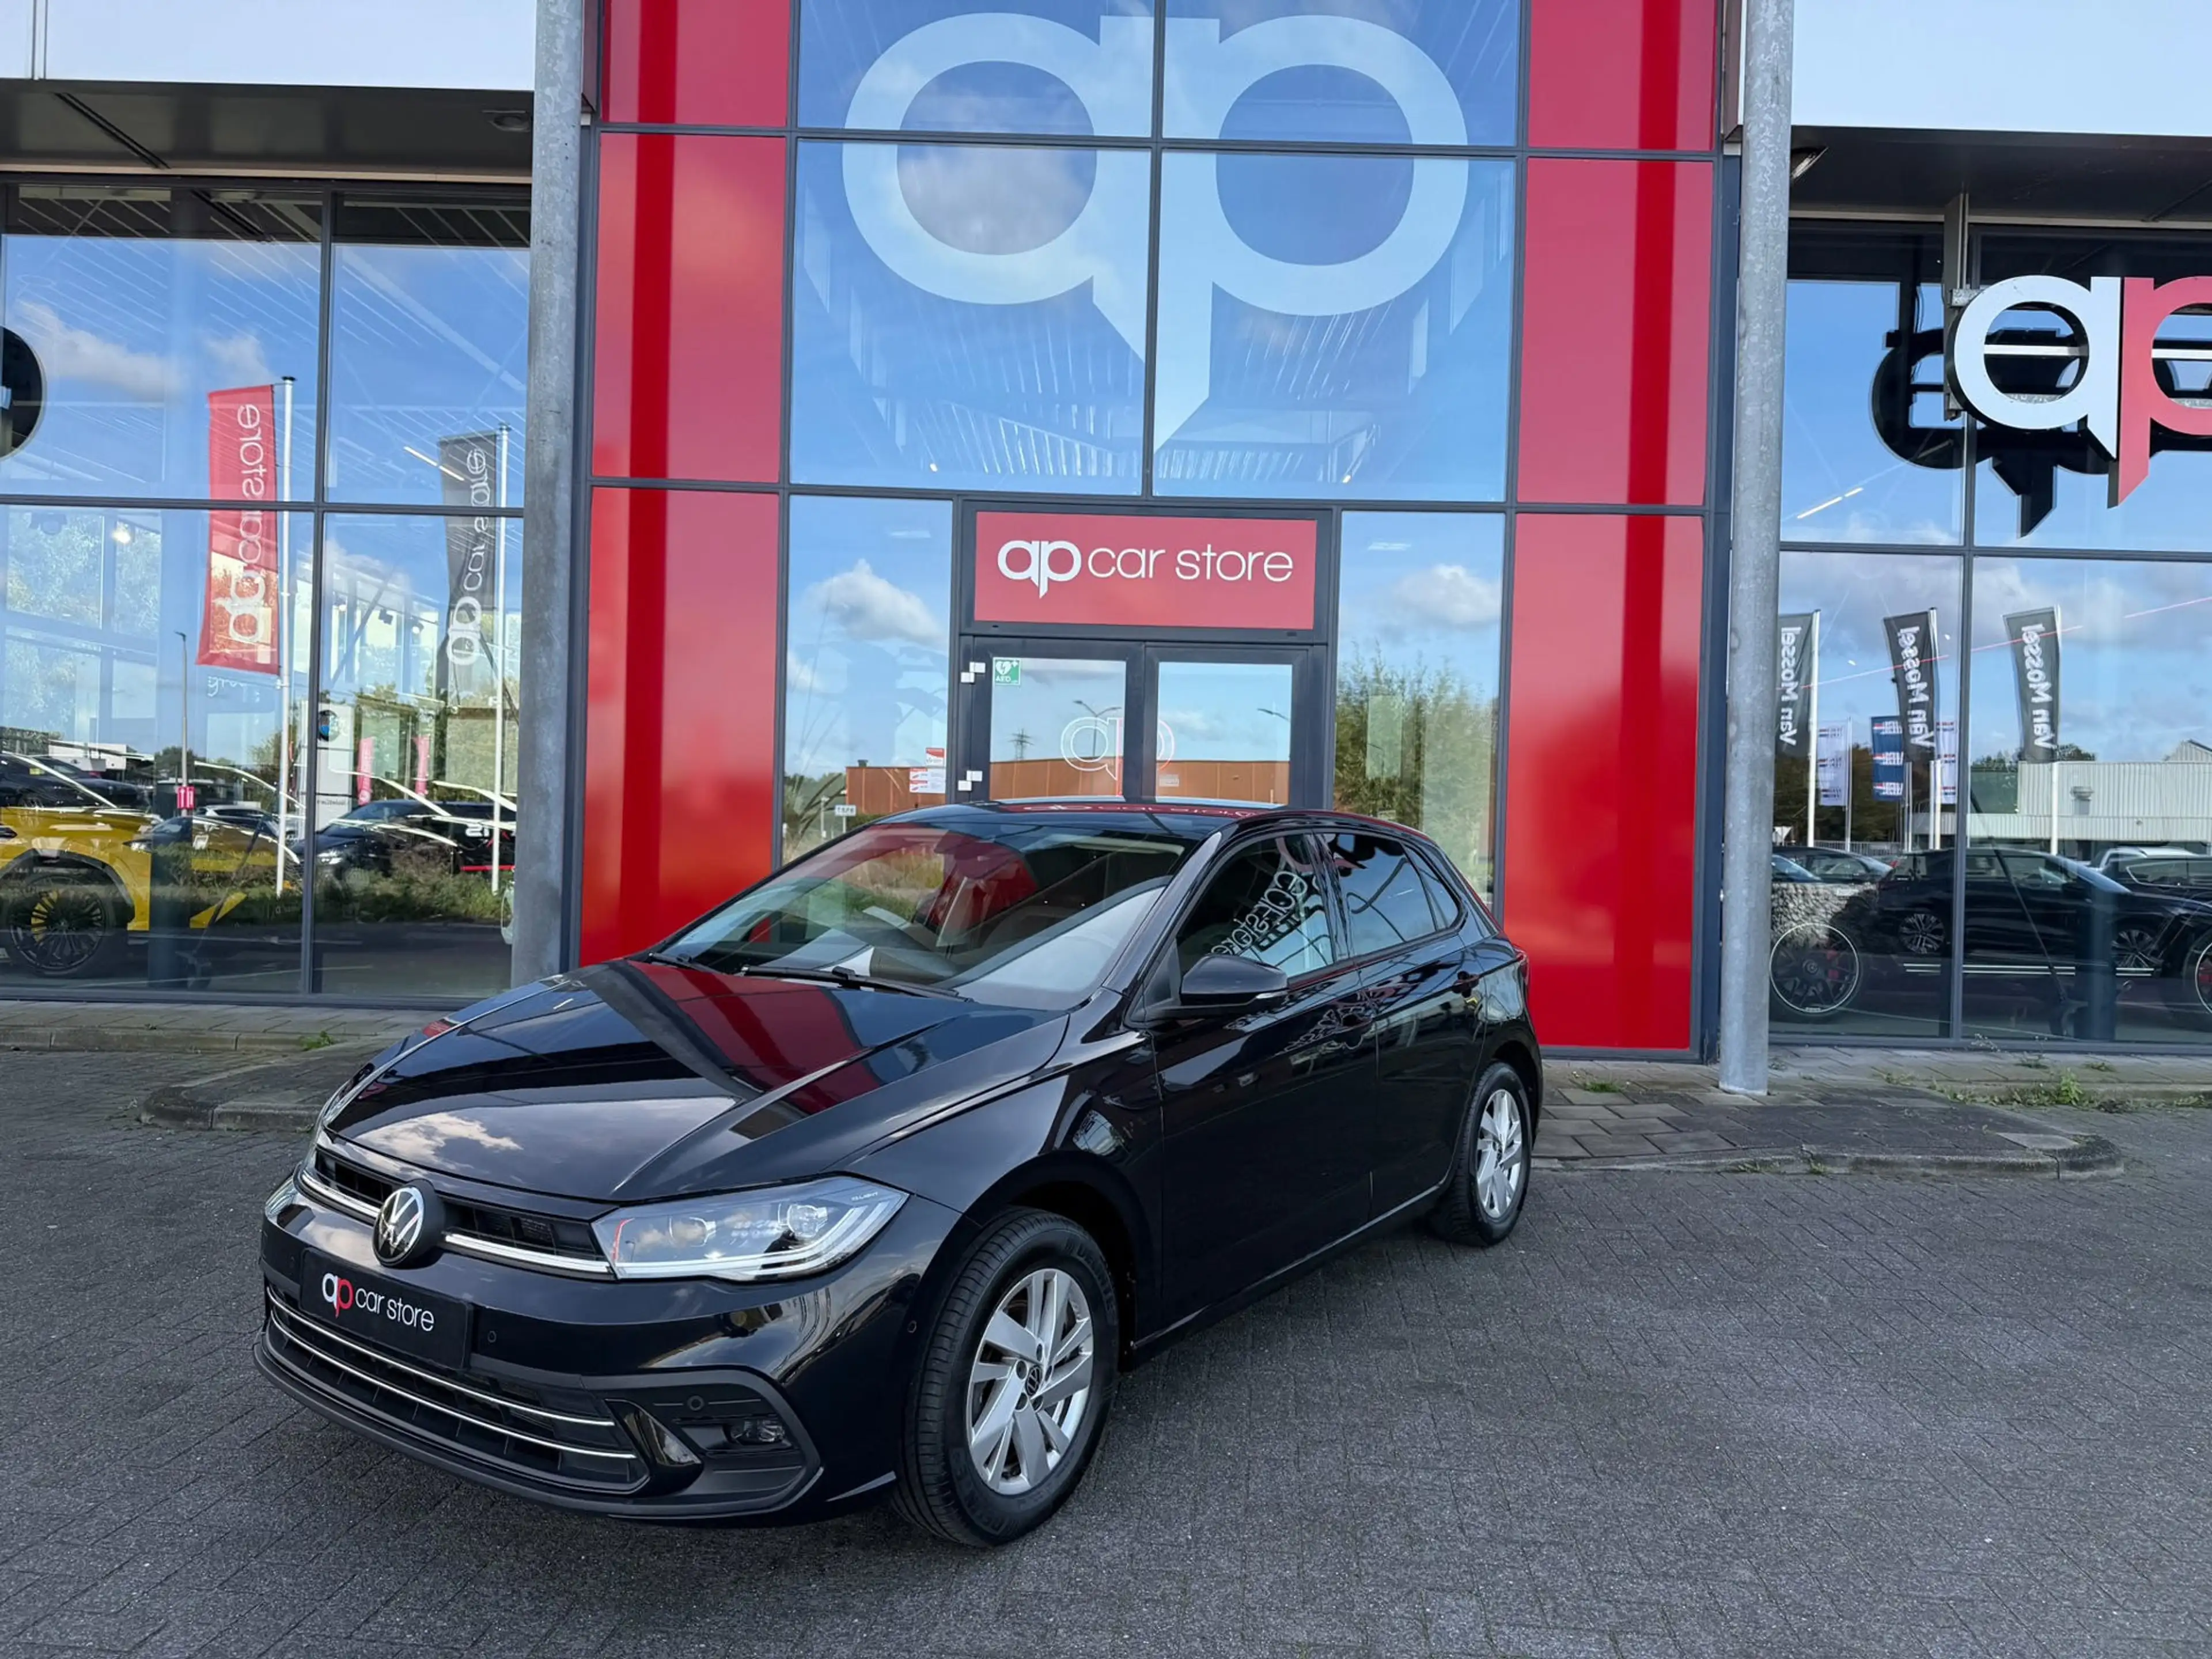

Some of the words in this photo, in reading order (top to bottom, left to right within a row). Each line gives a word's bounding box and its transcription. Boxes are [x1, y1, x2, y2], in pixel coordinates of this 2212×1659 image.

[997, 540, 1081, 599] ap
[1088, 548, 1166, 579] car
[1175, 544, 1294, 582] store
[322, 1272, 355, 1320] ap
[355, 1287, 385, 1315] car
[387, 1297, 435, 1332] store
